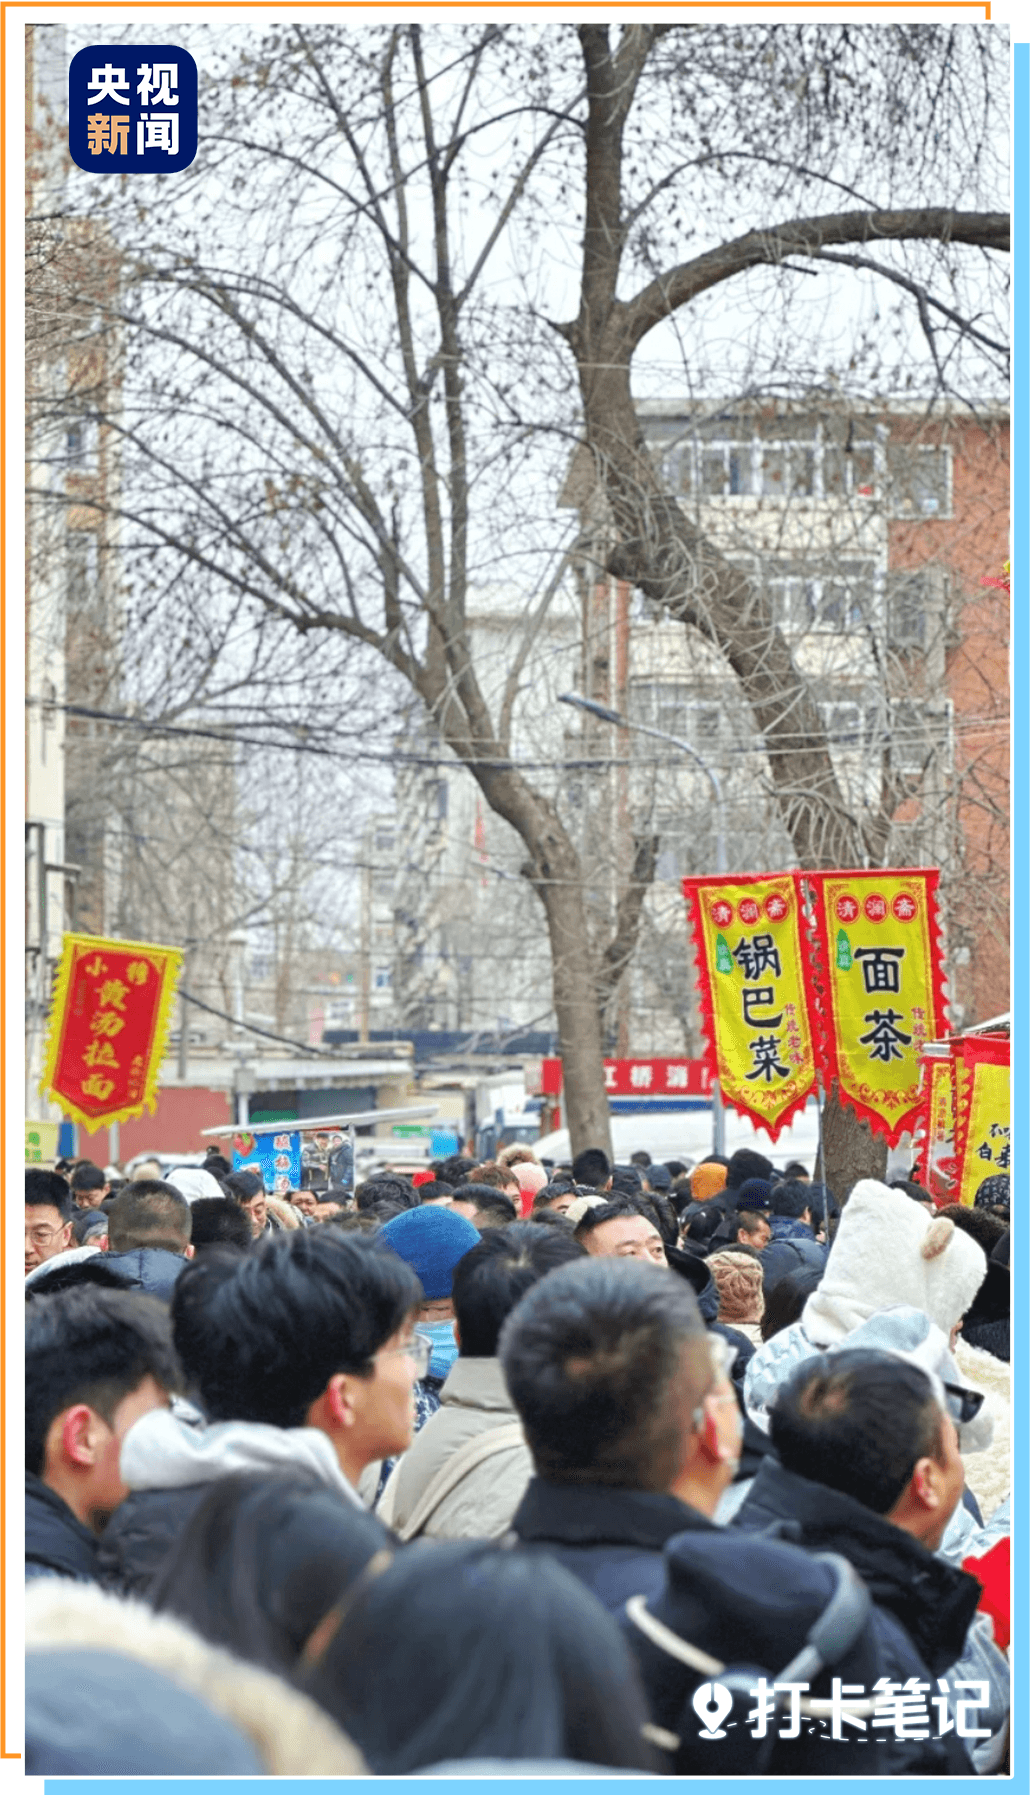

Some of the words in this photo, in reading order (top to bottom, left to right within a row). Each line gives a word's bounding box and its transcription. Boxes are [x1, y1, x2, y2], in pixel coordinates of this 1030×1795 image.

[732, 933, 790, 1083] 锅巴菜
[853, 947, 912, 1062] 面茶
